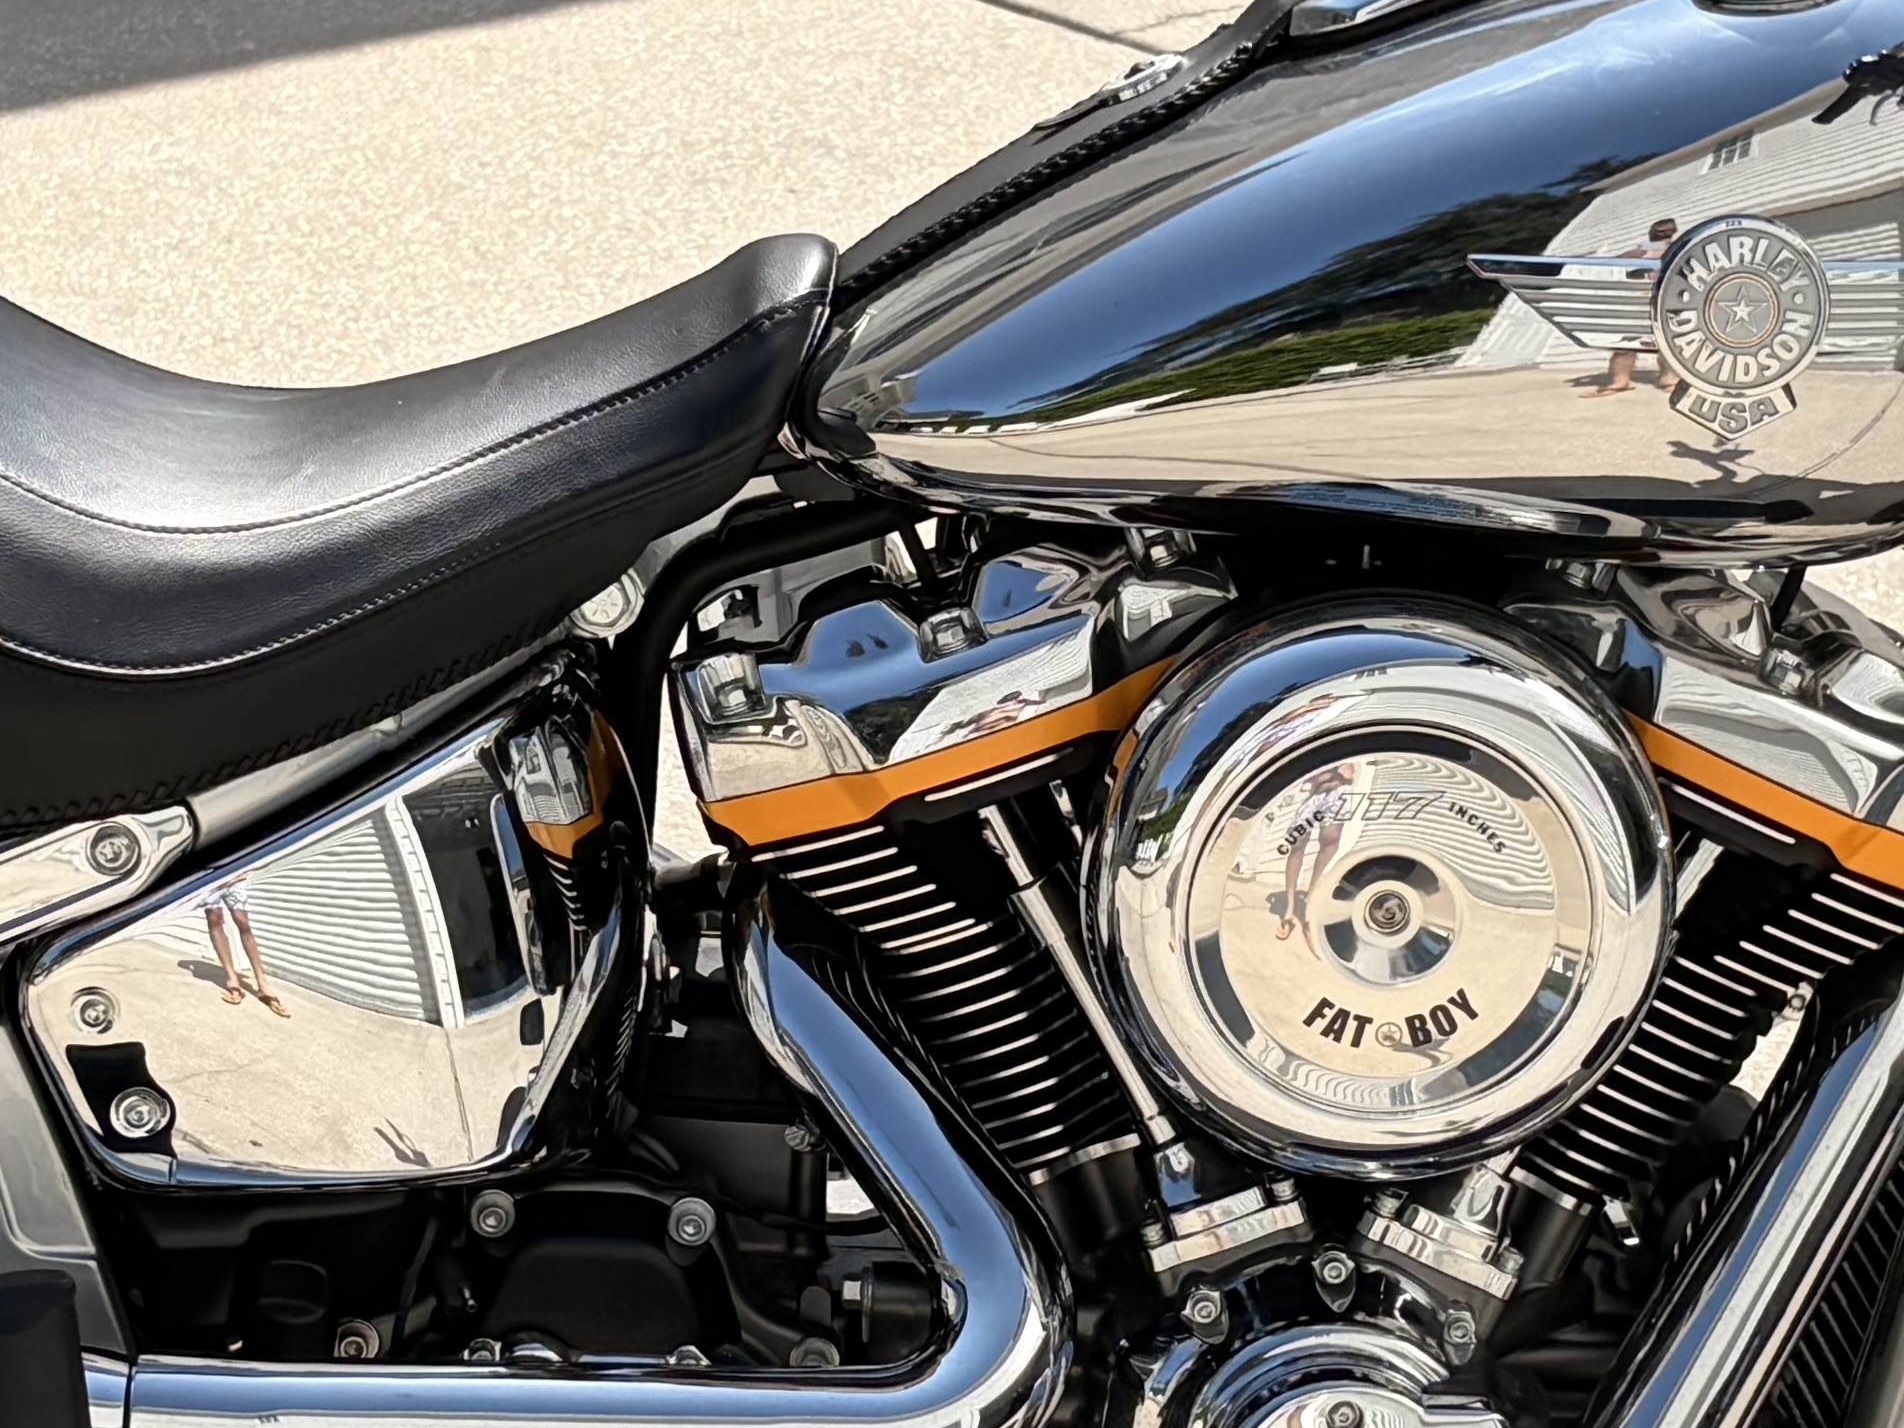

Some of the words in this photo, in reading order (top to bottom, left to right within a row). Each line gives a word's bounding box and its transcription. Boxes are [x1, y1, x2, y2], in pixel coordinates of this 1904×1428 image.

[1680, 236, 1810, 292] HARLEY
[1666, 309, 1814, 383] DAVIDSON
[1688, 396, 1780, 434] USA
[1277, 810, 1325, 856] CUBIC
[1333, 790, 1446, 821] 117
[1449, 801, 1506, 854] INCHES
[1302, 996, 1374, 1048] FAT
[1405, 987, 1480, 1048] BOY
